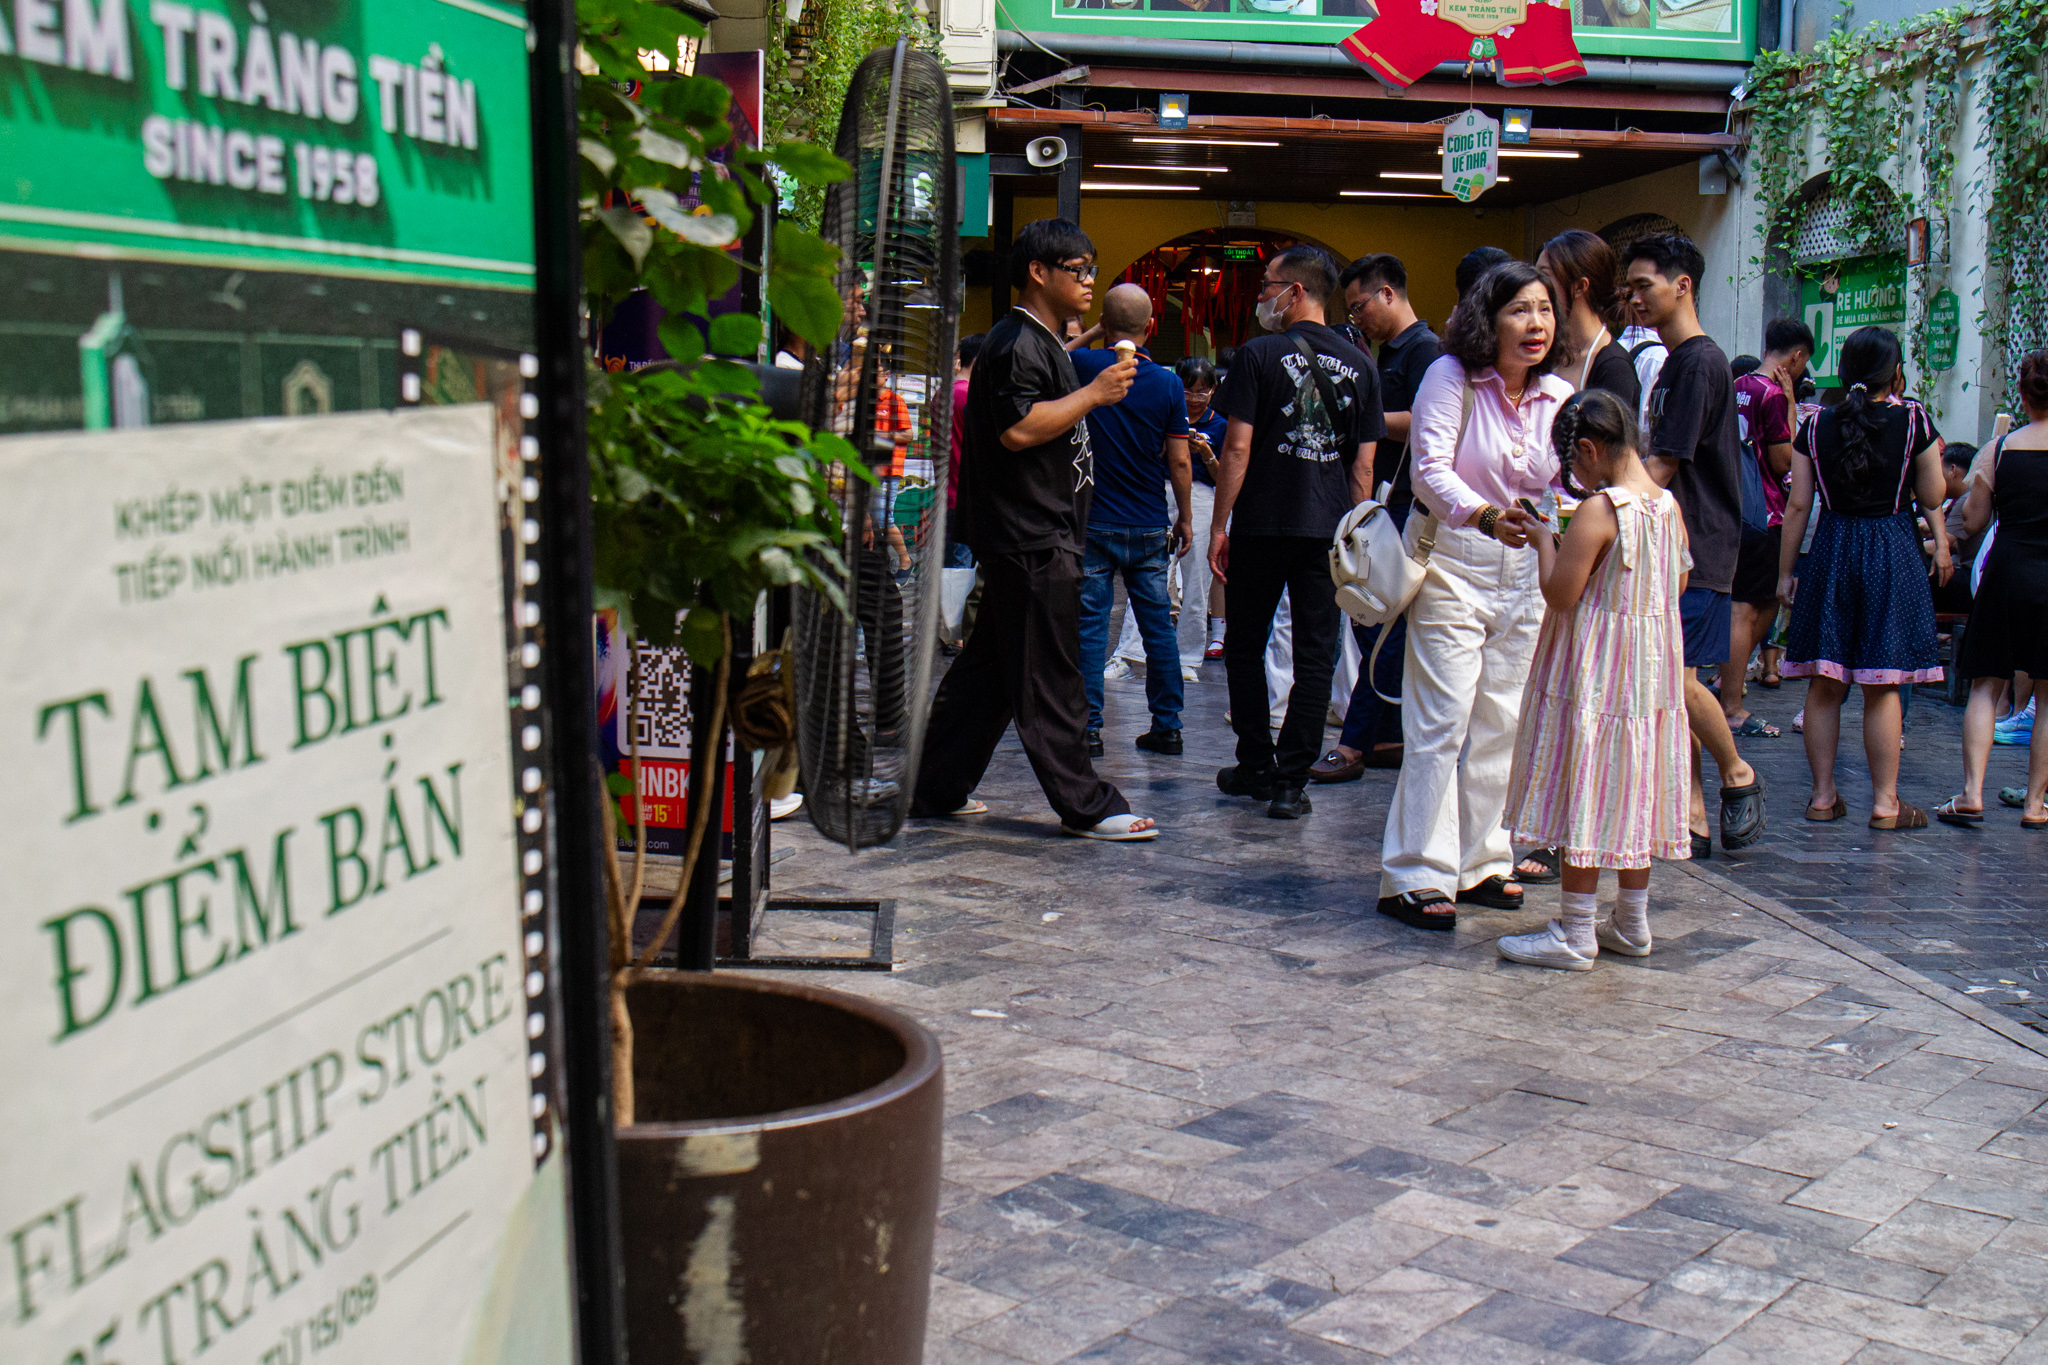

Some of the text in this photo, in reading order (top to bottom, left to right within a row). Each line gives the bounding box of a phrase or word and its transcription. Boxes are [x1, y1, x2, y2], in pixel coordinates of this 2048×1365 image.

[1469, 4, 1497, 13] TRÀNG
[1499, 5, 1517, 14] TIỀN
[0, 0, 478, 150] EM TRÀNG TIỀN
[142, 114, 380, 207] SINCE 1958
[1476, 125, 1494, 148] TẾT
[1281, 352, 1308, 369] Th
[1844, 314, 1856, 324] MUA
[1857, 313, 1870, 323] KEM
[1319, 451, 1341, 463] Stree
[113, 482, 204, 541] KHÉP
[208, 474, 272, 532] MỘT
[112, 515, 411, 606] TIẾP NỐI HÀNH TRÌNH
[36, 594, 452, 831] TẠM BIỆT
[40, 758, 465, 1045] ĐIỂM BÁN
[6, 953, 514, 1325] FLAGSHIP STORE
[138, 1166, 362, 1365] TRÀNG
[370, 1072, 489, 1216] TIỀN
[309, 1272, 379, 1352] 15/09
